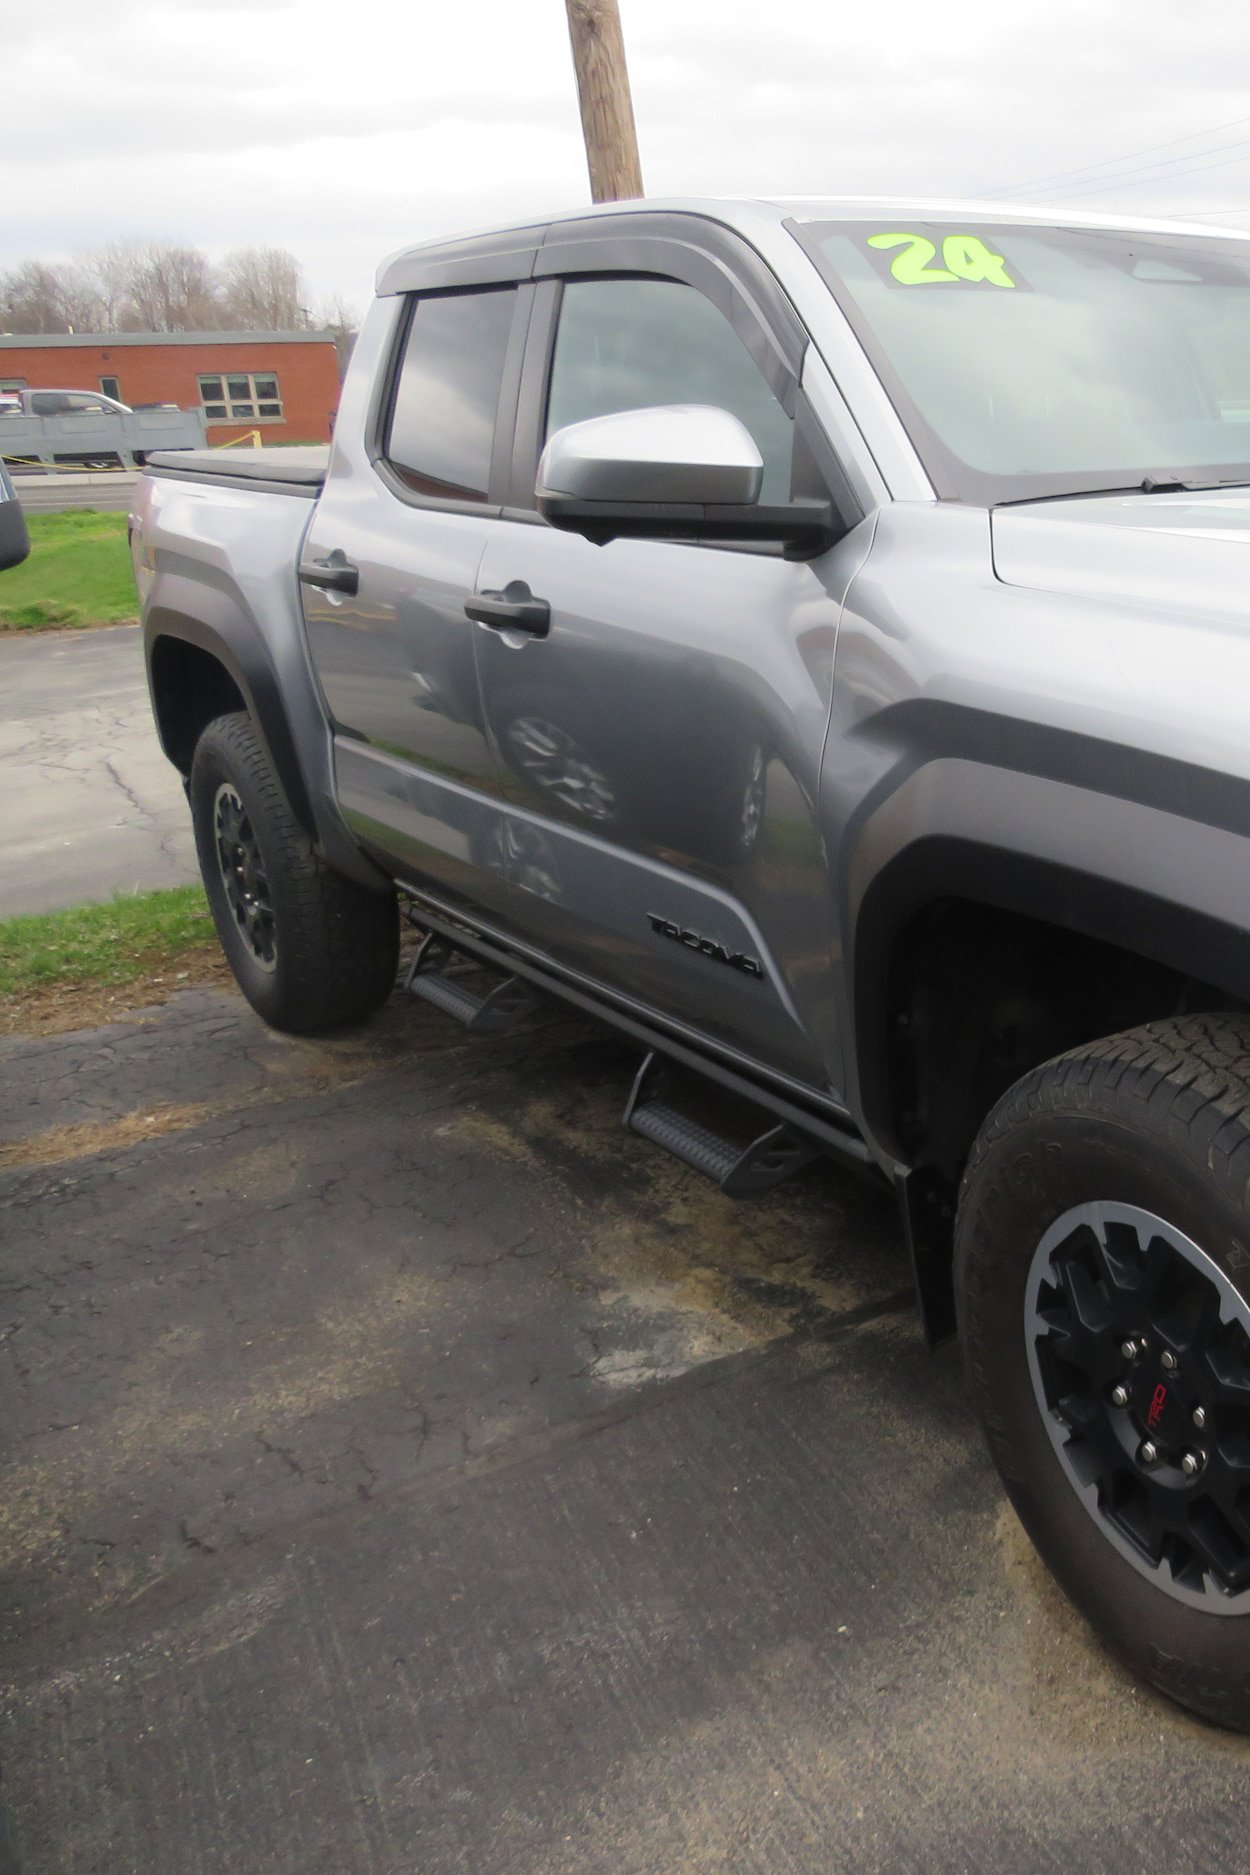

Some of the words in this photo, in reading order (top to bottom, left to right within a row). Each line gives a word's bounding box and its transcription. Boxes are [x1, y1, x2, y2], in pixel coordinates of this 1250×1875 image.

[867, 233, 1016, 288] 24
[646, 912, 764, 979] TACOMA
[1147, 1384, 1167, 1427] TRD
